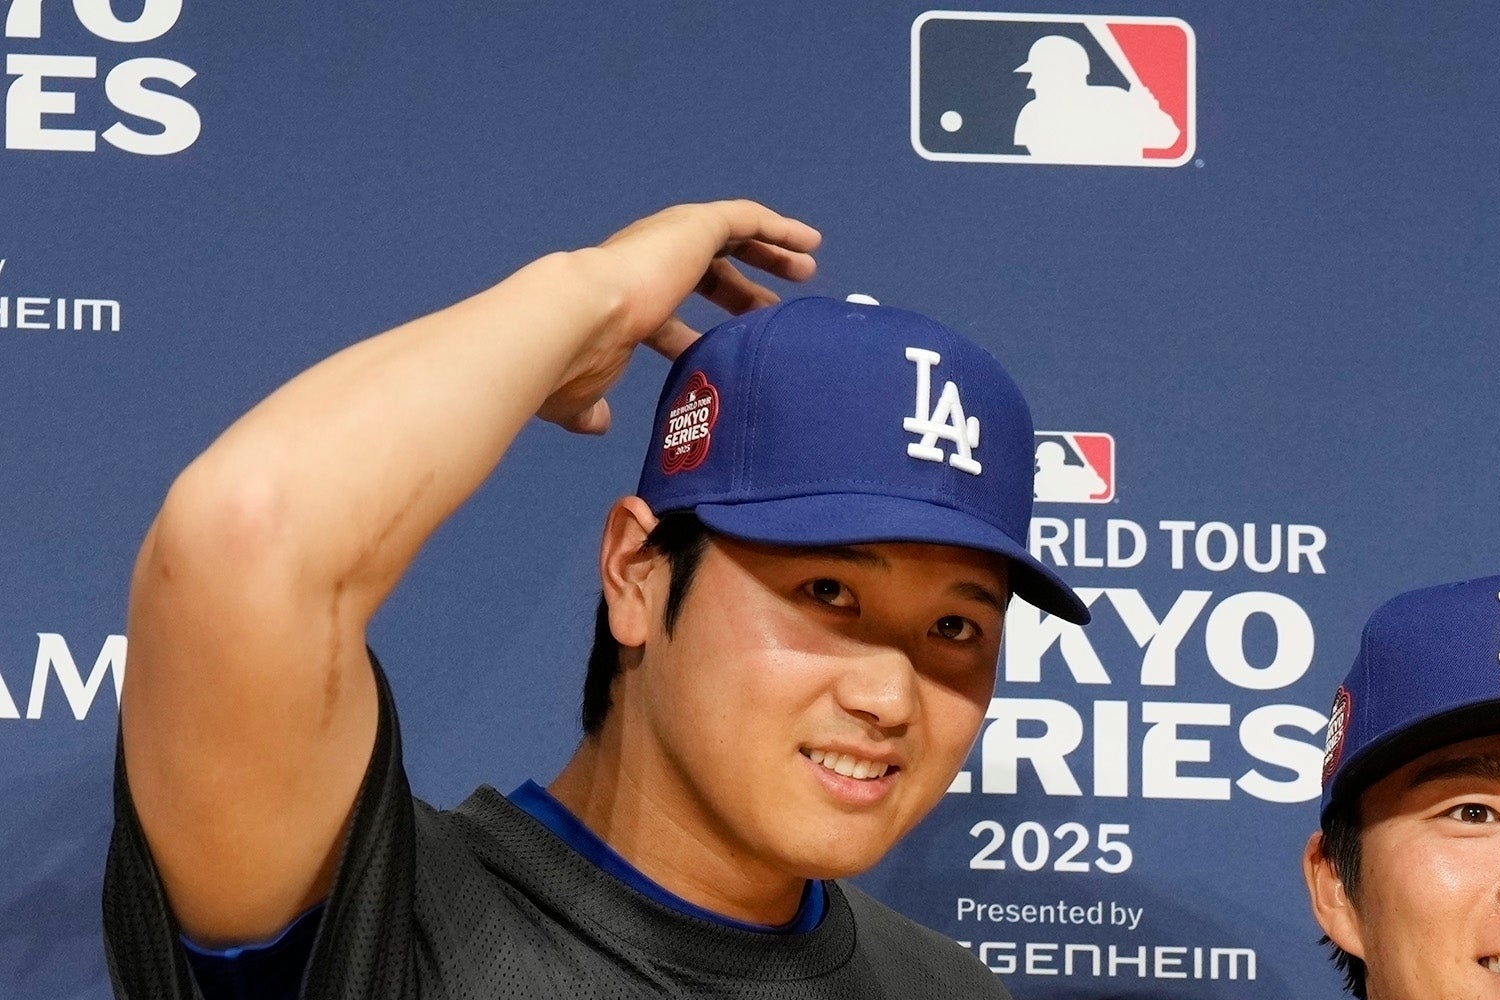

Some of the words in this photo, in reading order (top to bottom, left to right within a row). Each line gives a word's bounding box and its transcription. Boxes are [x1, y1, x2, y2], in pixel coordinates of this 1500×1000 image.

[669, 407, 709, 433] TOKYO
[903, 347, 982, 476] LA
[663, 422, 709, 449] SERIES
[1159, 520, 1327, 574] TOUR
[969, 820, 1133, 874] 2025
[957, 898, 1102, 925] Presented
[1110, 901, 1144, 930] by
[955, 940, 1257, 980] GENHEIM
